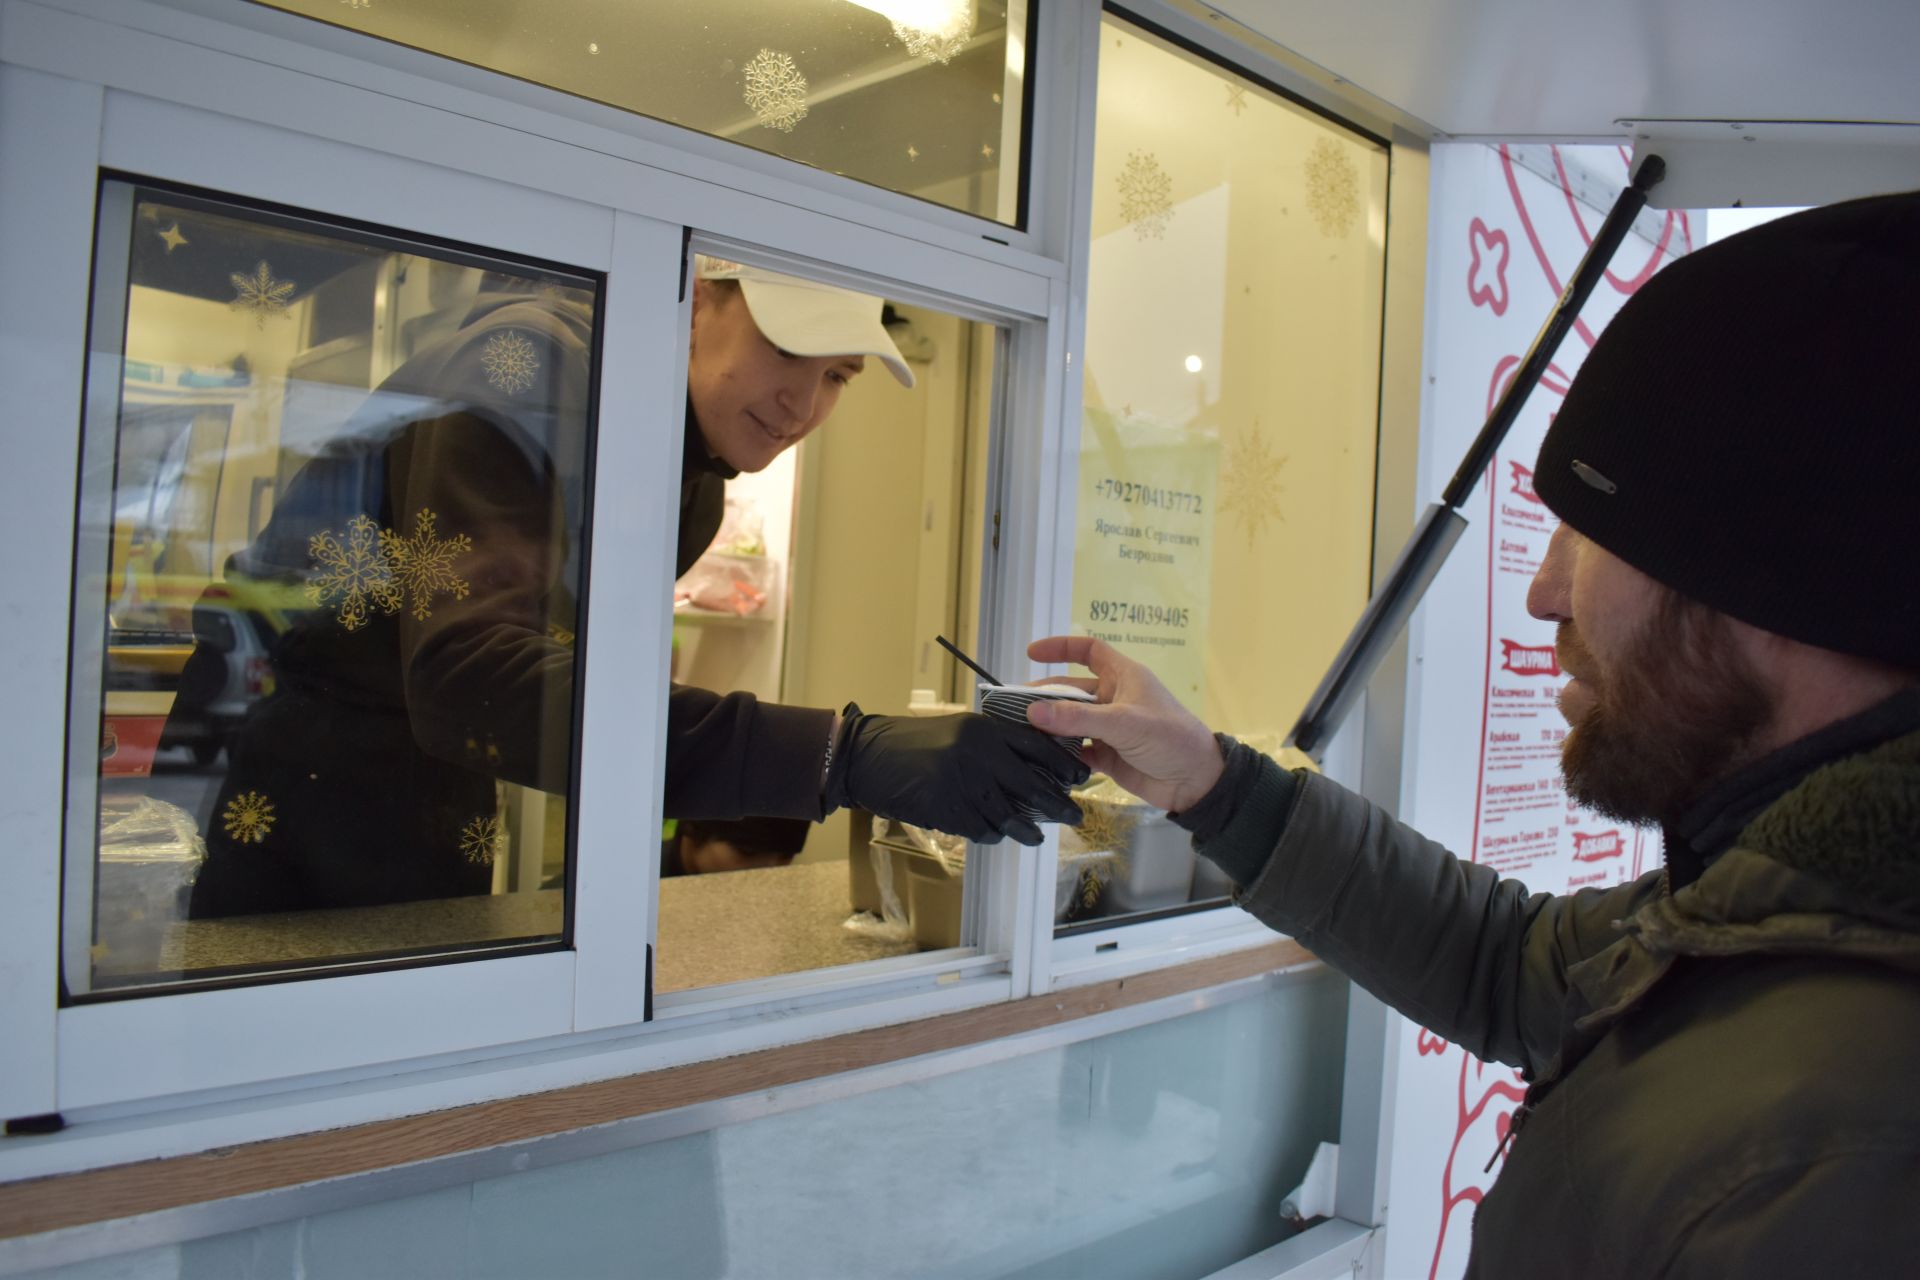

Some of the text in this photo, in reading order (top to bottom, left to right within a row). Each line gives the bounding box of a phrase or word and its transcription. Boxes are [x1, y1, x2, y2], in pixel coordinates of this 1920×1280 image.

[1095, 479, 1203, 514] +79270413772
[1095, 518, 1142, 538] Ярослав
[1090, 600, 1189, 628] 89274039405
[1511, 650, 1551, 669] ШАУРМА
[1579, 837, 1616, 857] ДОБАВКИ
